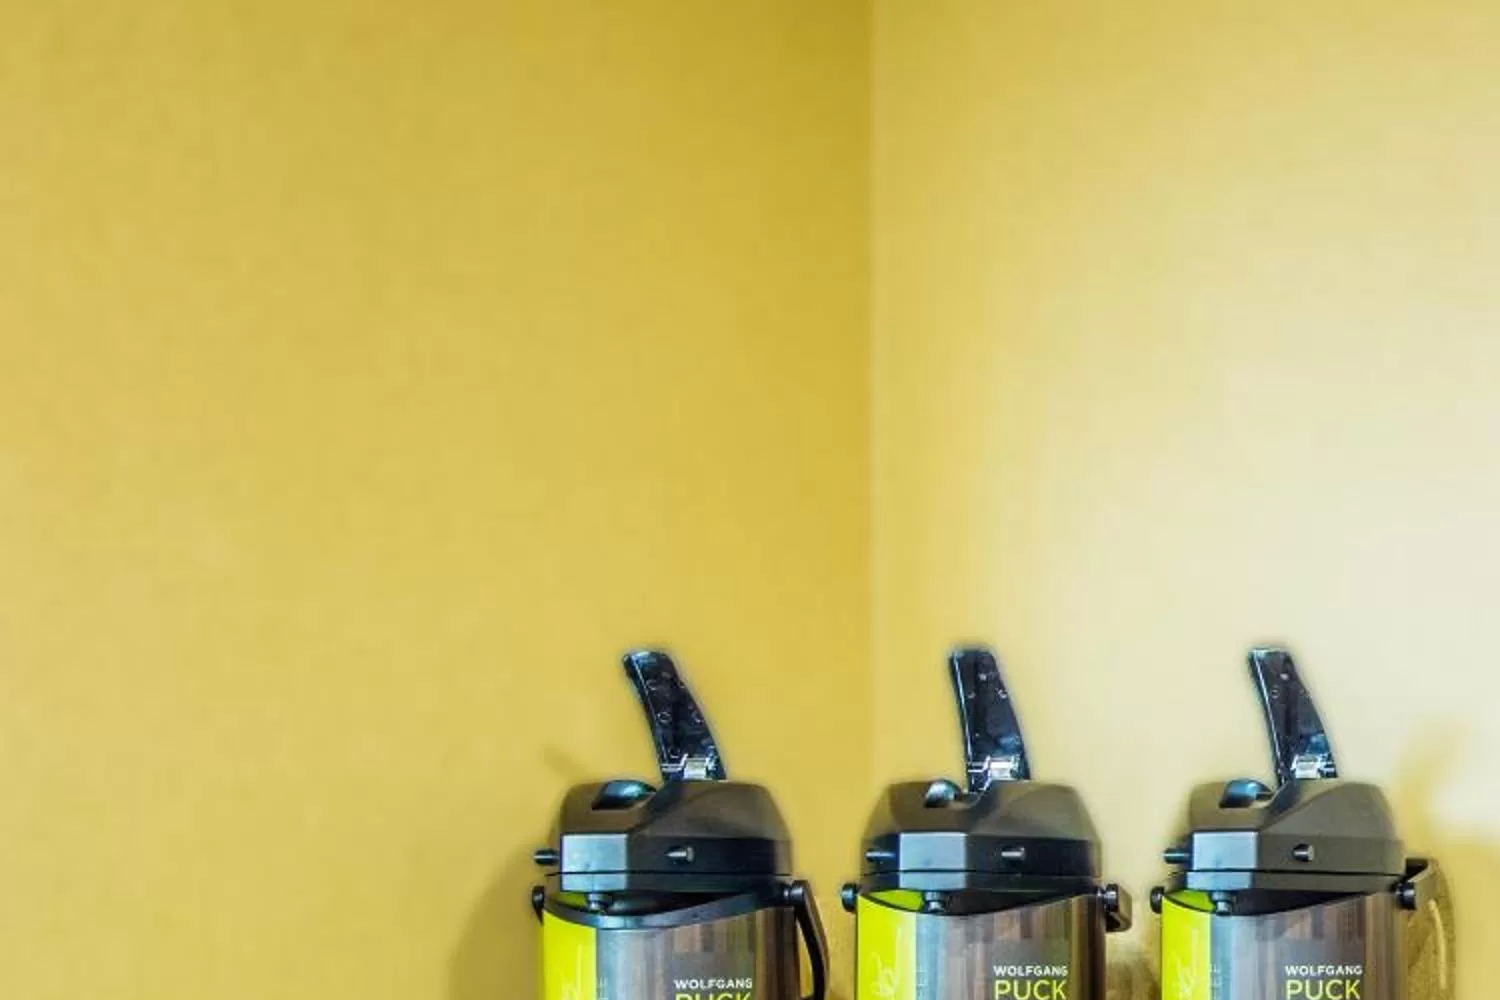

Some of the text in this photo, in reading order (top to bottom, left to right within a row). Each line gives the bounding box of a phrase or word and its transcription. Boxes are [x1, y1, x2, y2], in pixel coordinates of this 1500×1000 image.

[993, 965, 1068, 977] WOLFGANG
[1284, 964, 1363, 976] WOLFGANG
[673, 978, 753, 990] WOLFGANG
[994, 979, 1068, 1000] PUCK
[1285, 979, 1361, 1000] PUCK
